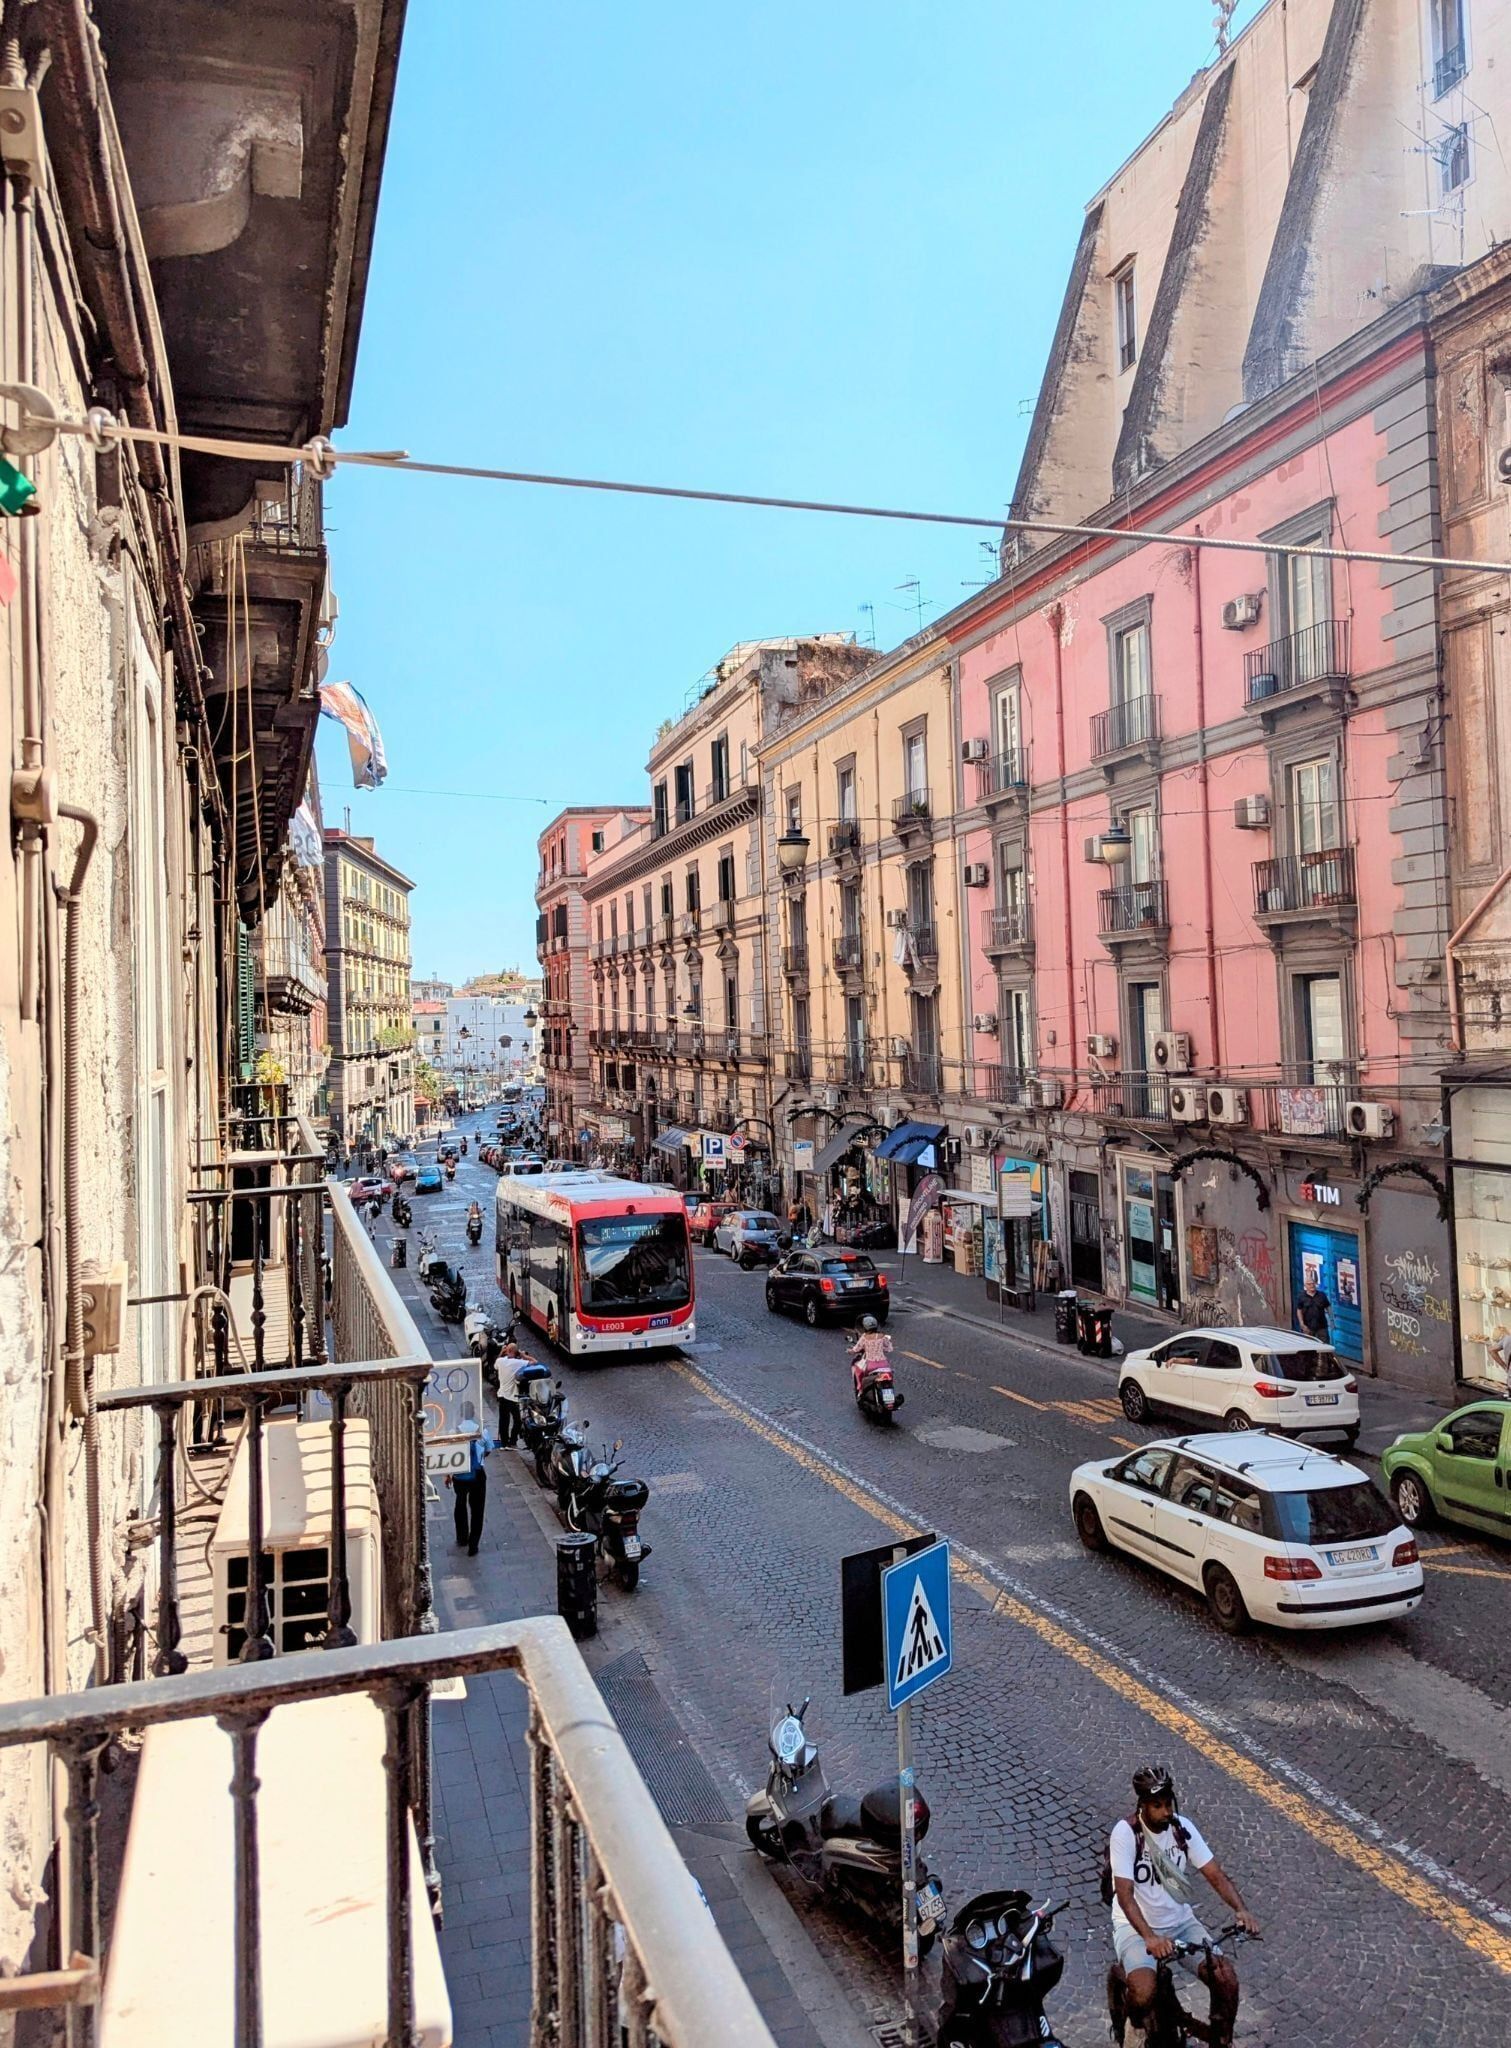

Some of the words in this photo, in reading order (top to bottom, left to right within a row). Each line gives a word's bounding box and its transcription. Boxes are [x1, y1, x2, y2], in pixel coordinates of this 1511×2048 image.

[709, 1139, 721, 1154] P
[948, 1138, 960, 1154] T
[912, 1177, 938, 1211] FRONTLINE
[1314, 1184, 1340, 1206] TIM
[601, 1323, 625, 1331] LE003
[651, 1316, 669, 1327] anm
[1387, 1307, 1421, 1337] BOBO
